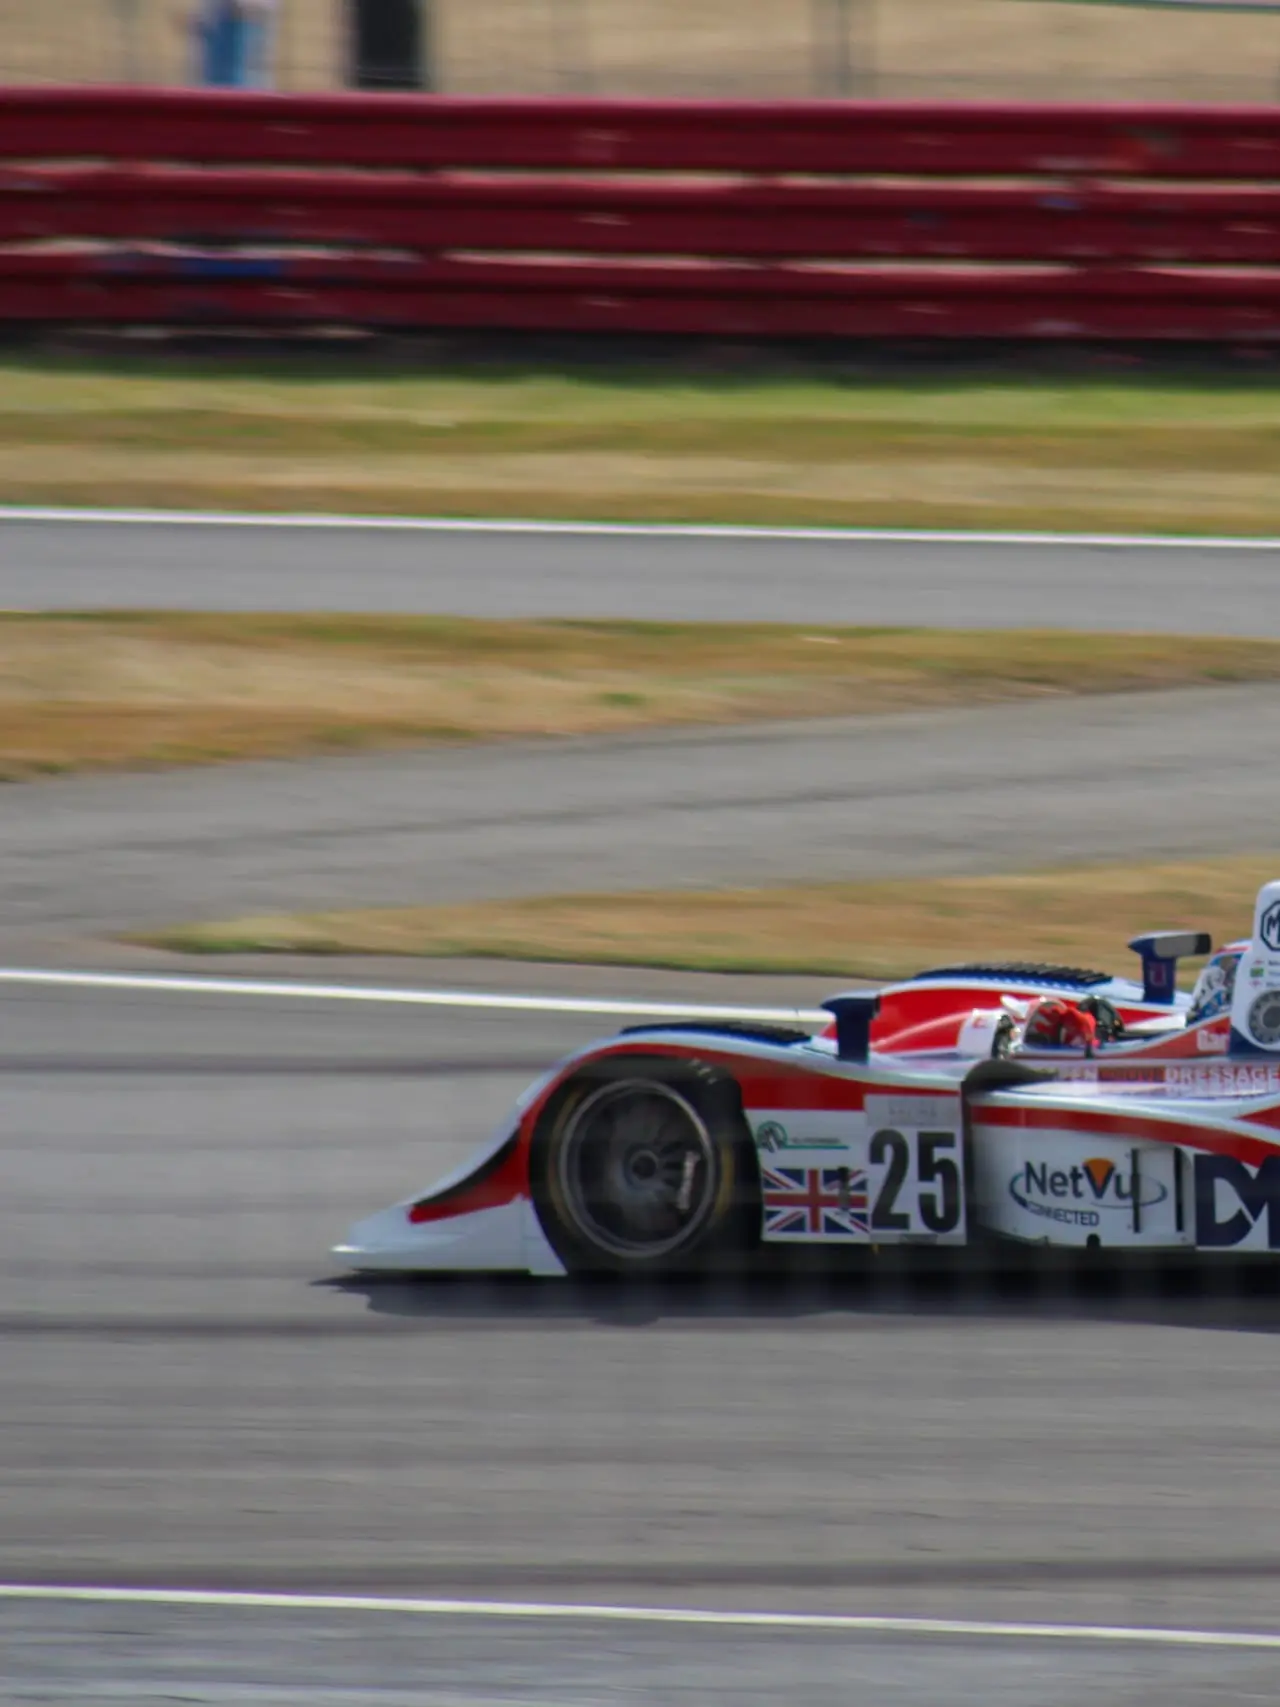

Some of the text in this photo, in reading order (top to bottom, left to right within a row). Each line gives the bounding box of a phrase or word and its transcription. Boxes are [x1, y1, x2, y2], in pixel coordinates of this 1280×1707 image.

[1165, 1063, 1280, 1085] DRESSAGE
[869, 1128, 961, 1234] 25
[1025, 1158, 1138, 1200] NetVu
